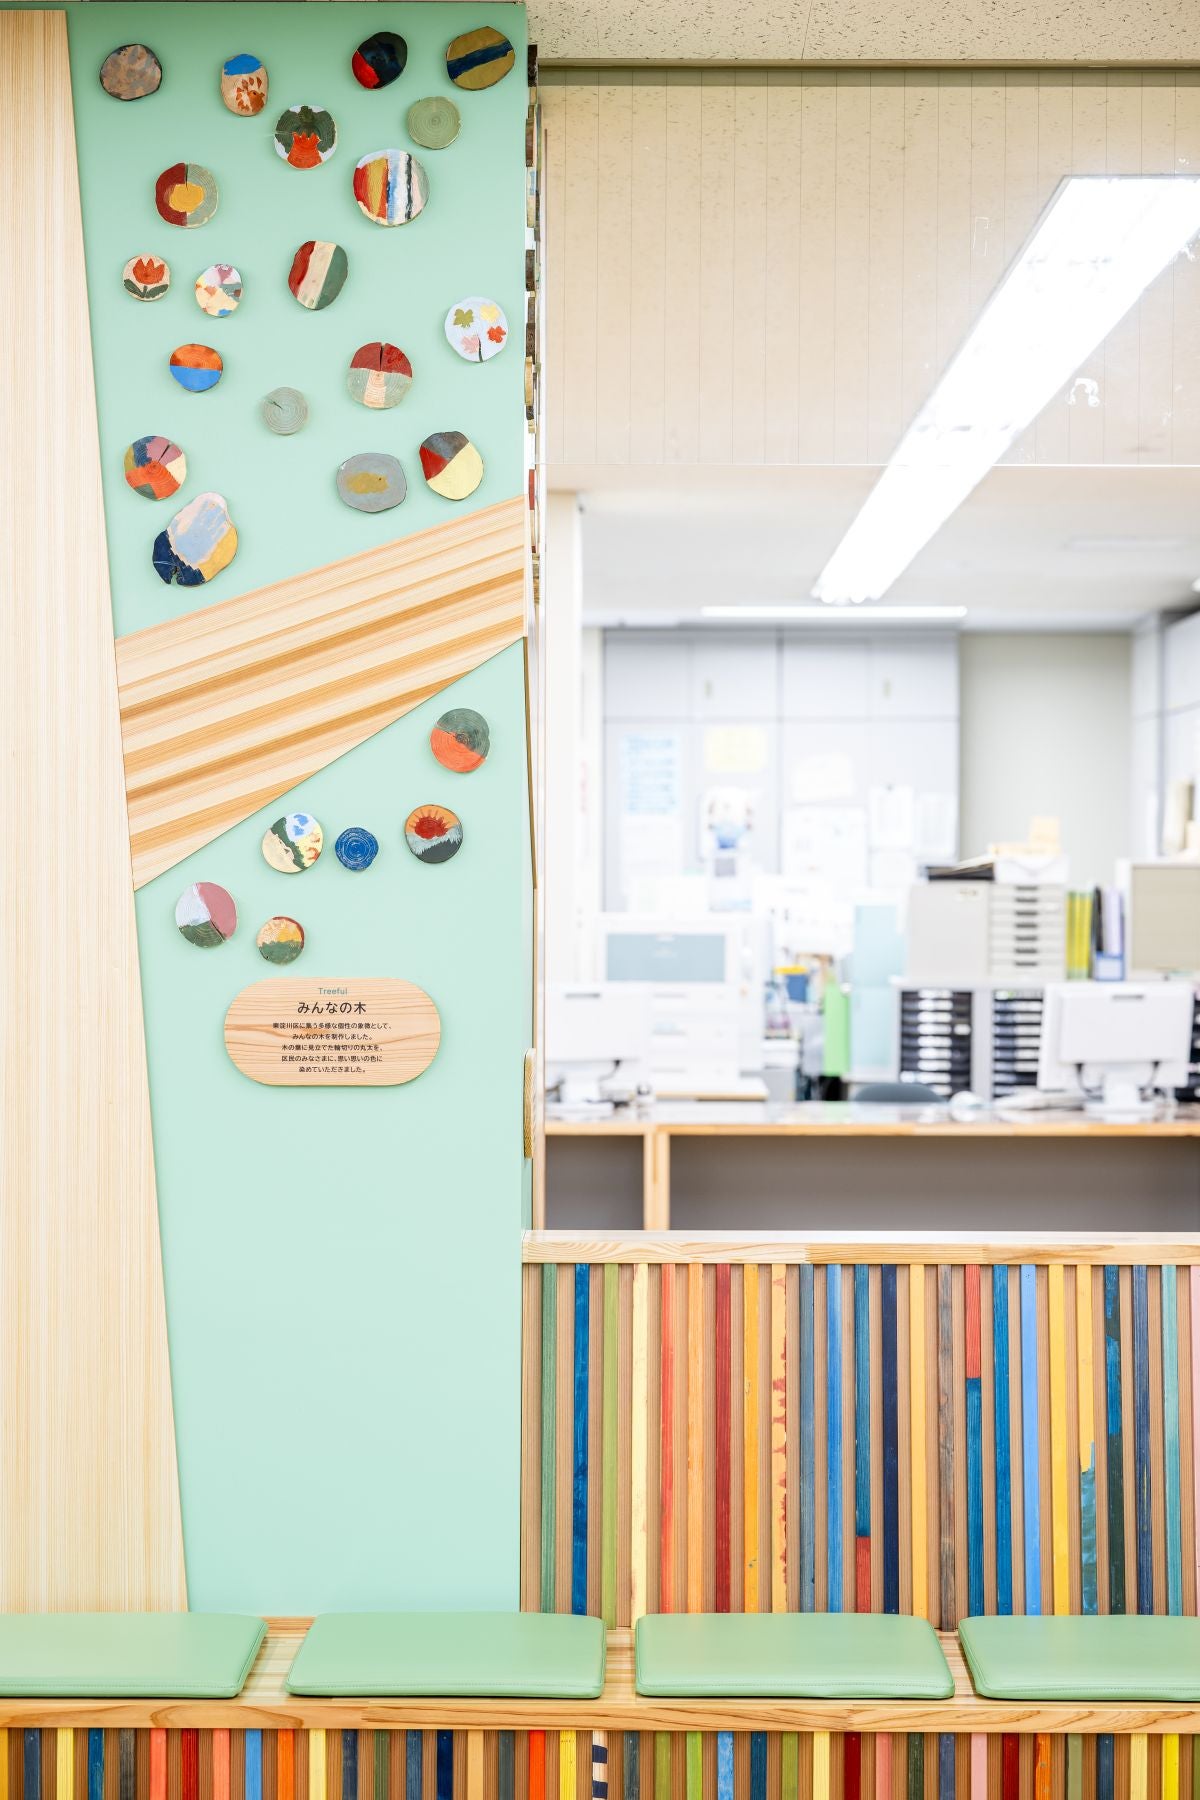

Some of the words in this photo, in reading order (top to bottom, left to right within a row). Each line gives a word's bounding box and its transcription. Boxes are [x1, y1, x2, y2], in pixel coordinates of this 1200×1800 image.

[318, 987, 348, 995] Treeful
[297, 1001, 366, 1015] みんなの木
[292, 1033, 373, 1041] みんなの木を制作しました。
[281, 1044, 383, 1052] 木の葉に見立てた輪切りの丸太を、
